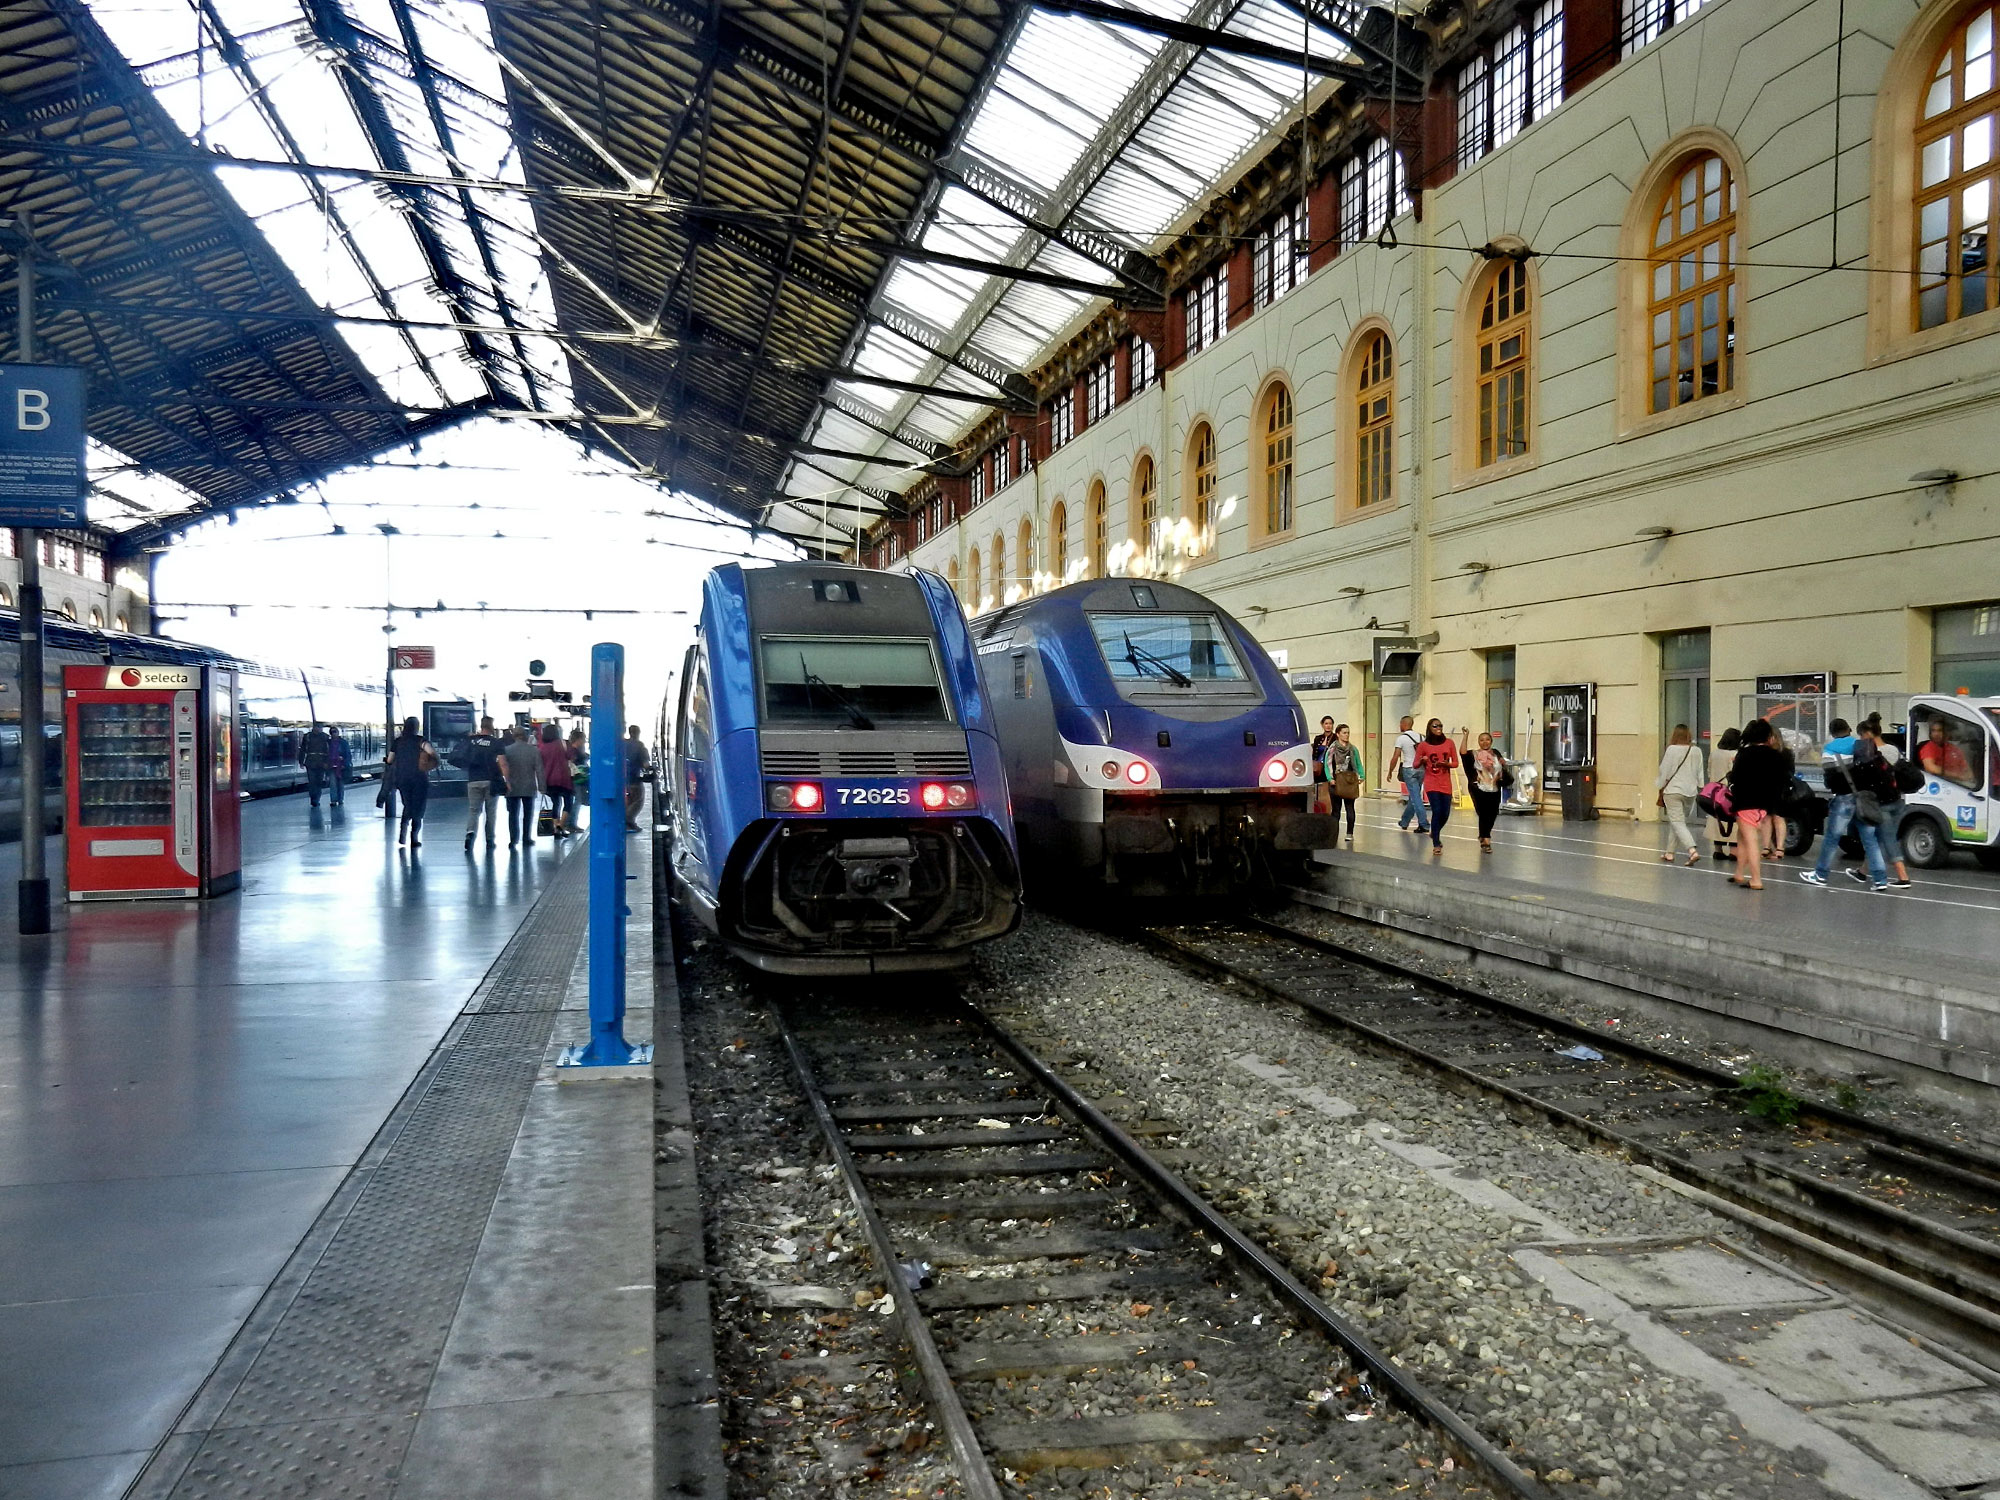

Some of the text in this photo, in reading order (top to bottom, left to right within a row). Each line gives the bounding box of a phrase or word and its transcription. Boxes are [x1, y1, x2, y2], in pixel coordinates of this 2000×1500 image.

[17, 388, 51, 431] B
[144, 673, 188, 683] selecta
[1764, 682, 1782, 690] Deon
[837, 788, 911, 804] 72625
